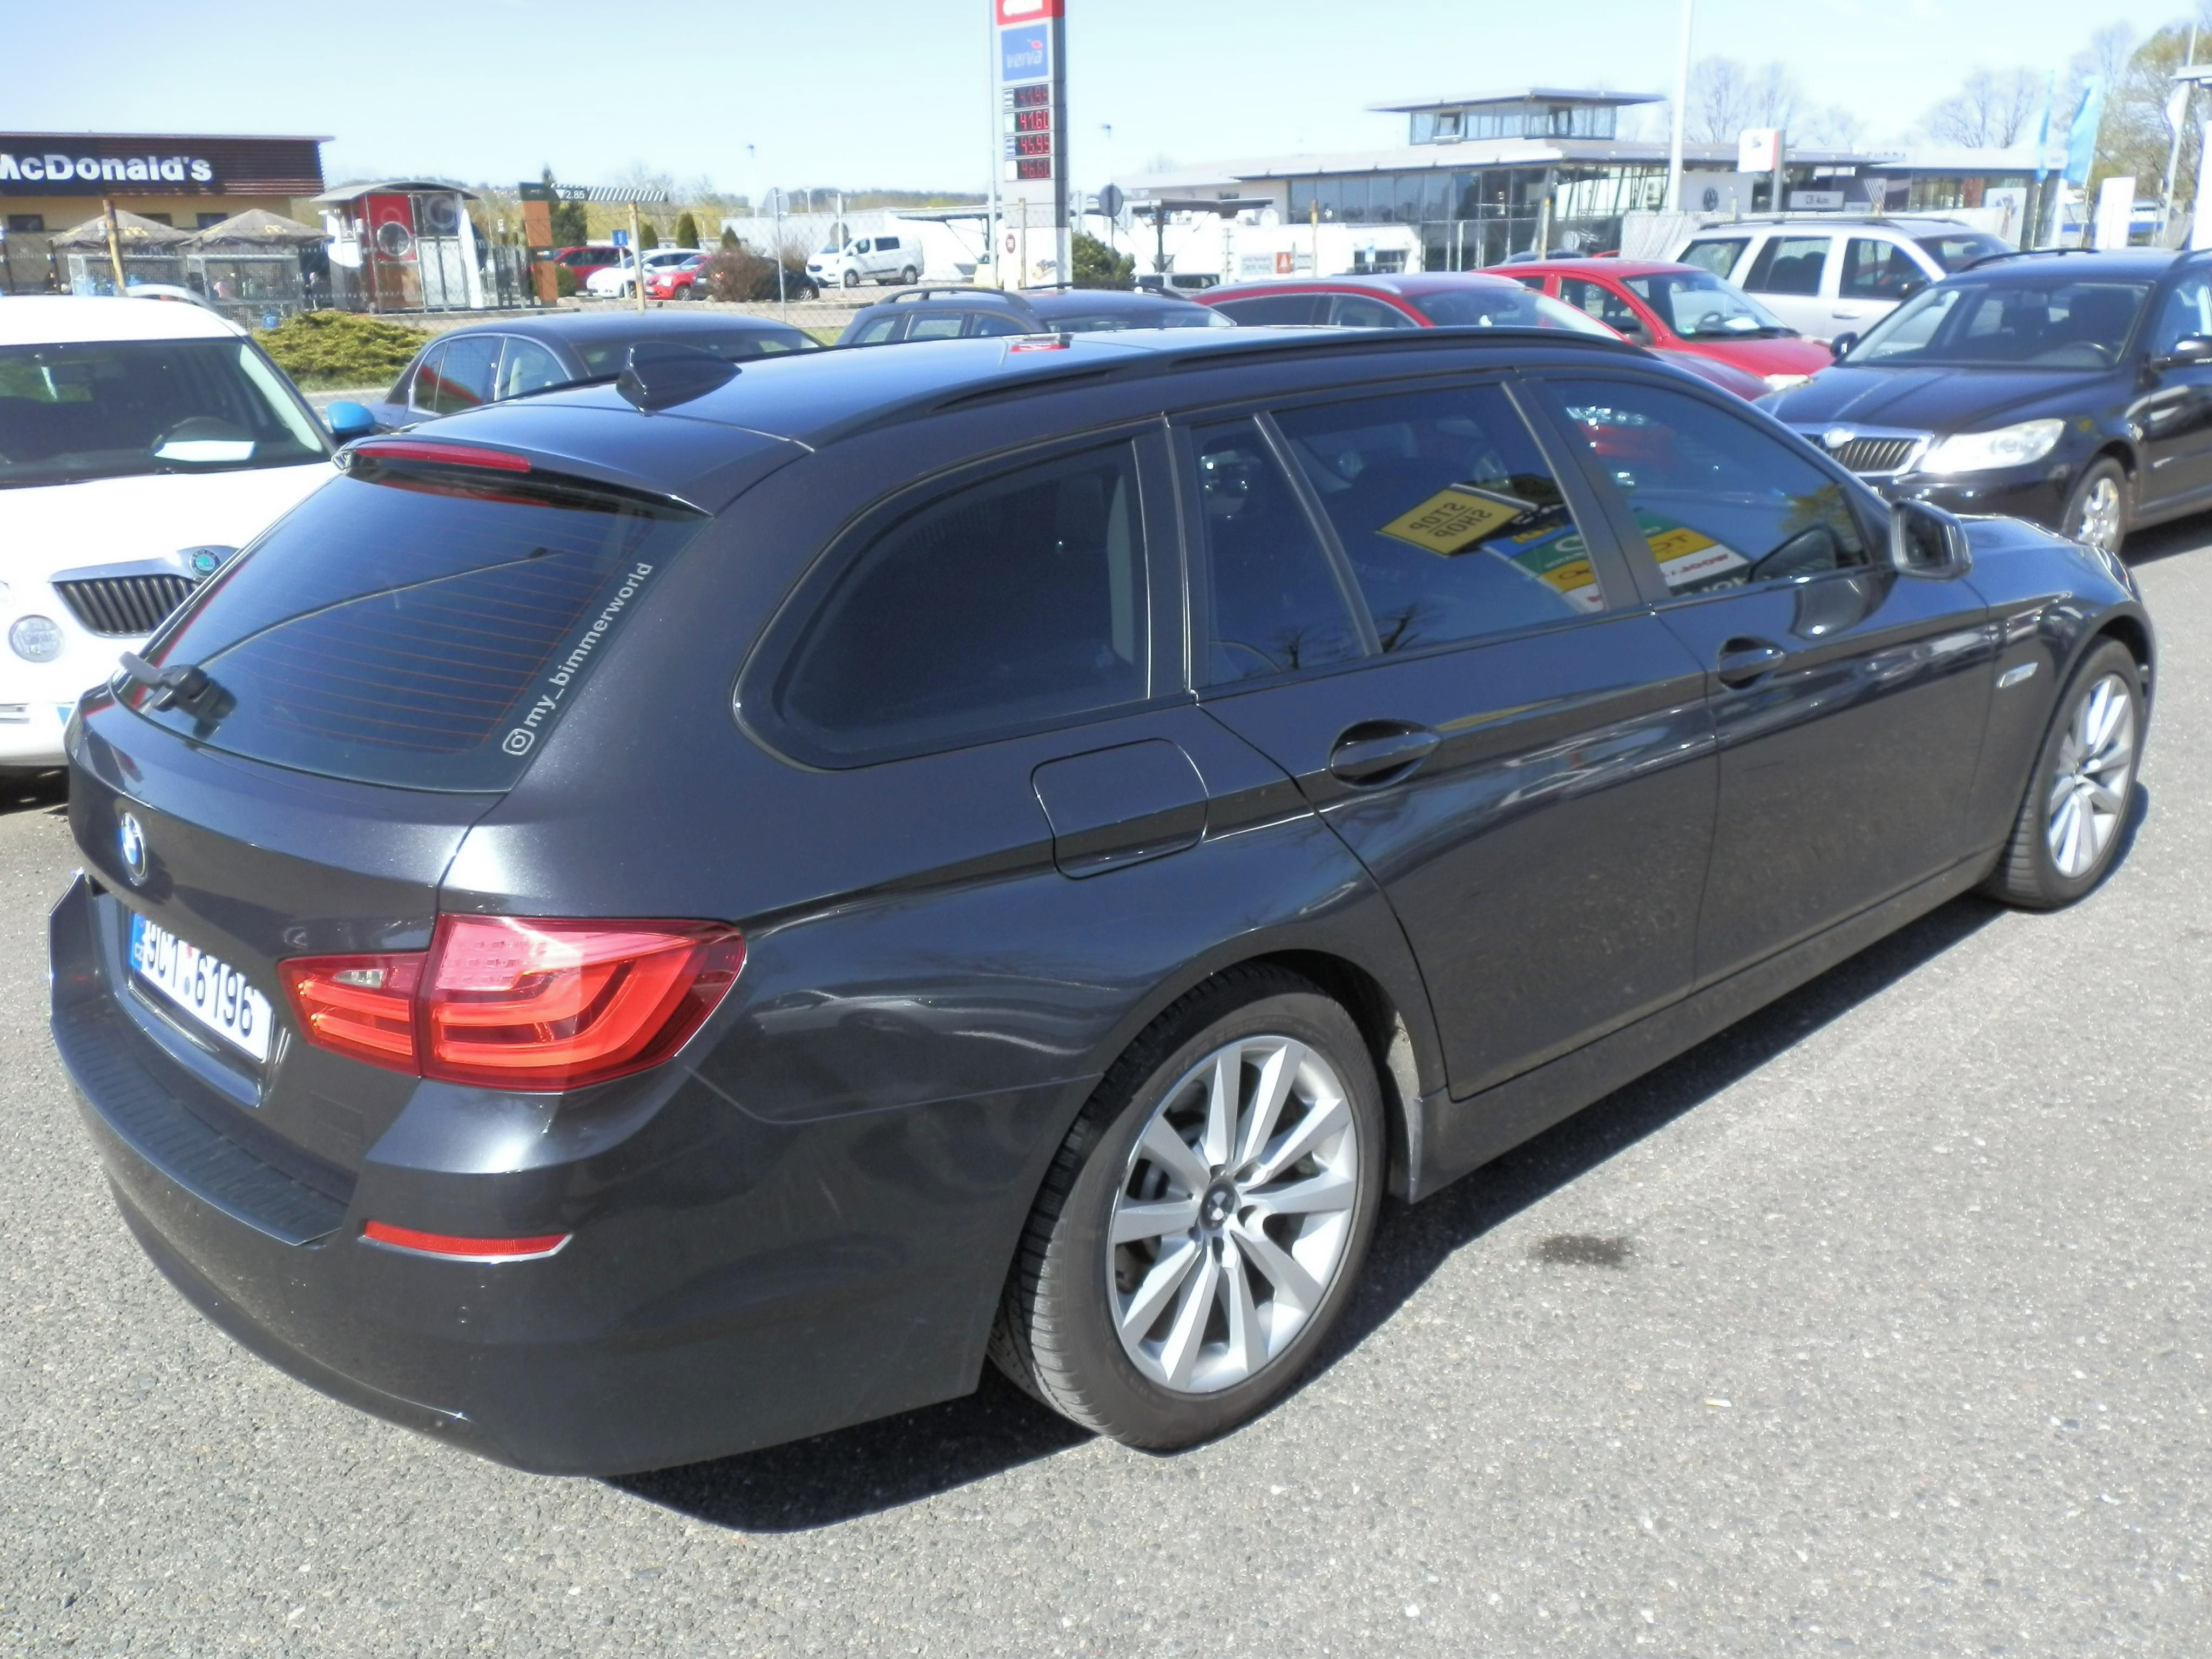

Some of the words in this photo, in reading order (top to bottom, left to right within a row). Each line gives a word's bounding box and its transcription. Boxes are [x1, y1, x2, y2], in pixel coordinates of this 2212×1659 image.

[1007, 50, 1043, 68] verva
[0, 154, 212, 182] McDonald's
[524, 563, 653, 727] my_bimmerworld
[194, 950, 253, 1038] 6196
